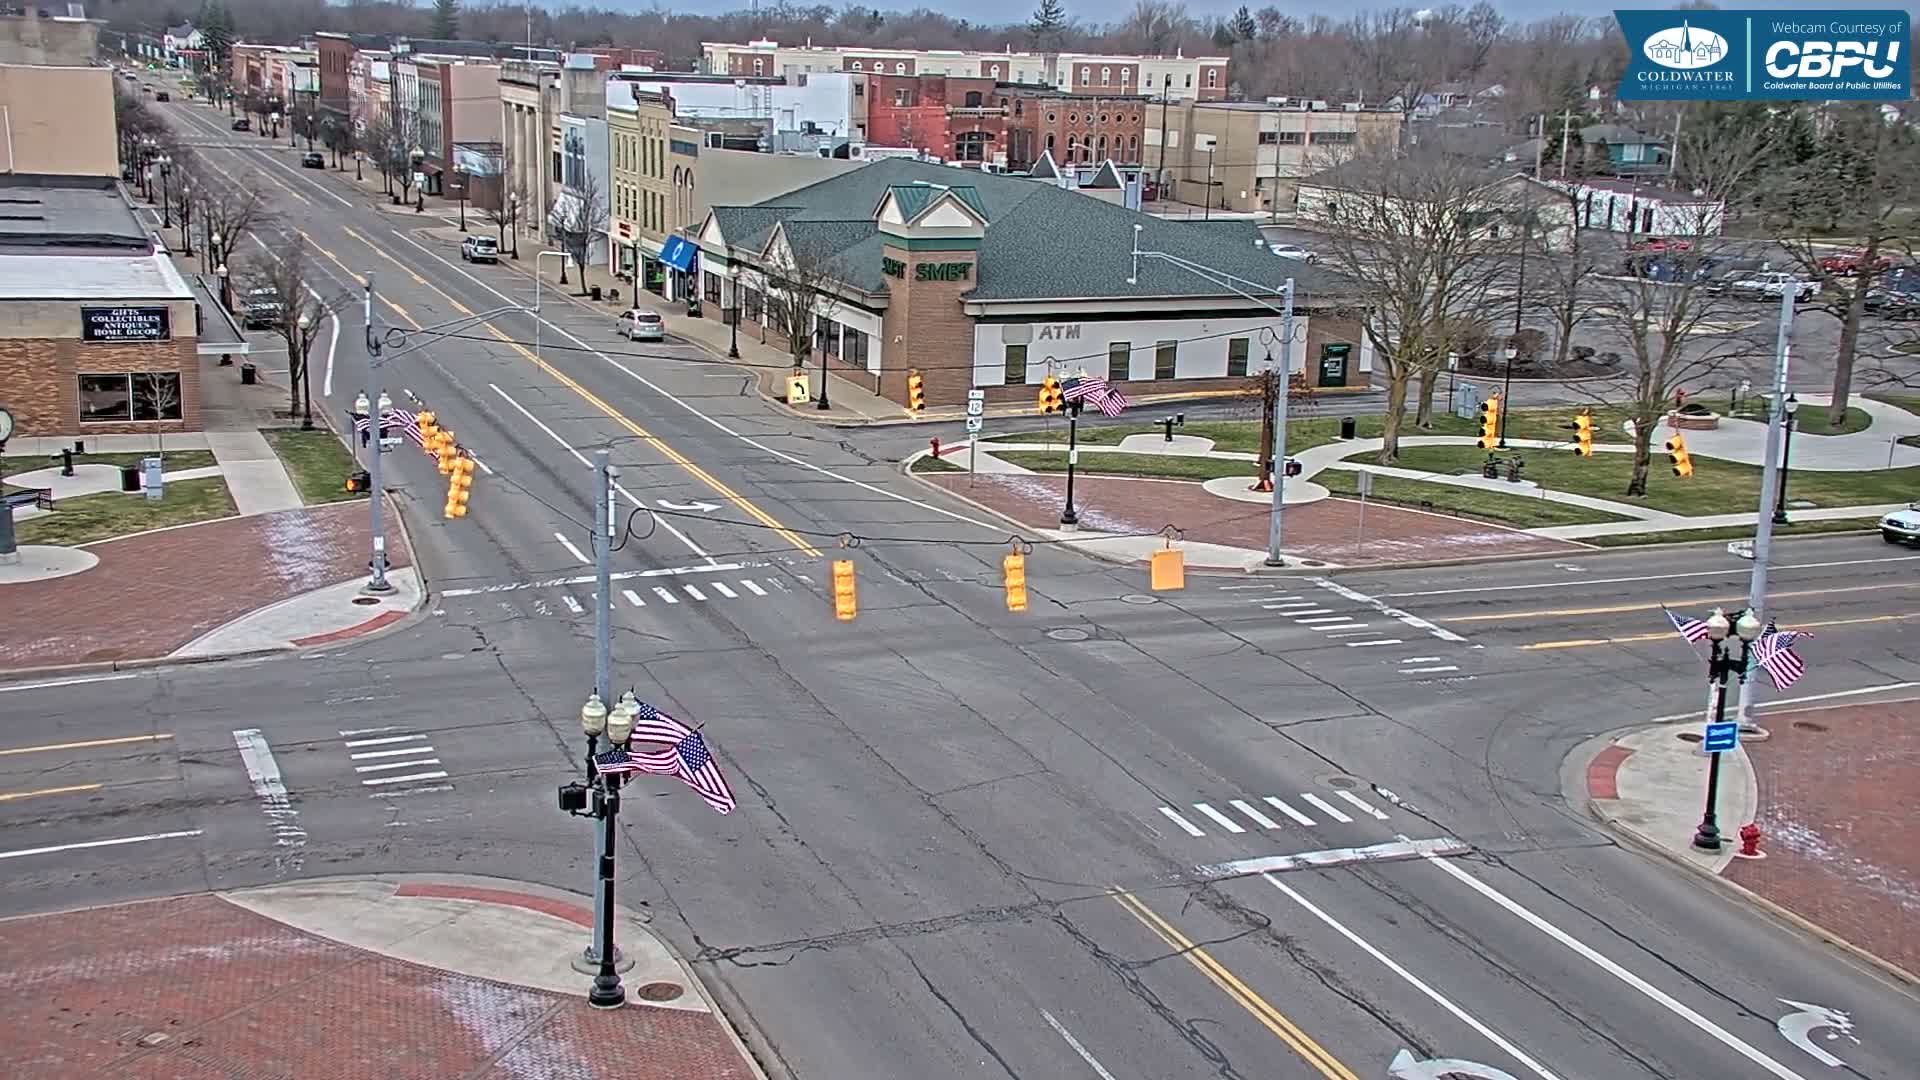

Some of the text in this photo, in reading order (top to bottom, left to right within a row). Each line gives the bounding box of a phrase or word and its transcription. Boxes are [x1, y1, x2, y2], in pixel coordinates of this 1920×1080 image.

[112, 308, 140, 316] GIFTS
[91, 315, 161, 323] COLLECTIBLES
[103, 322, 151, 330] ANTIQUES
[94, 329, 123, 337] HOME
[1039, 324, 1081, 340] ATM
